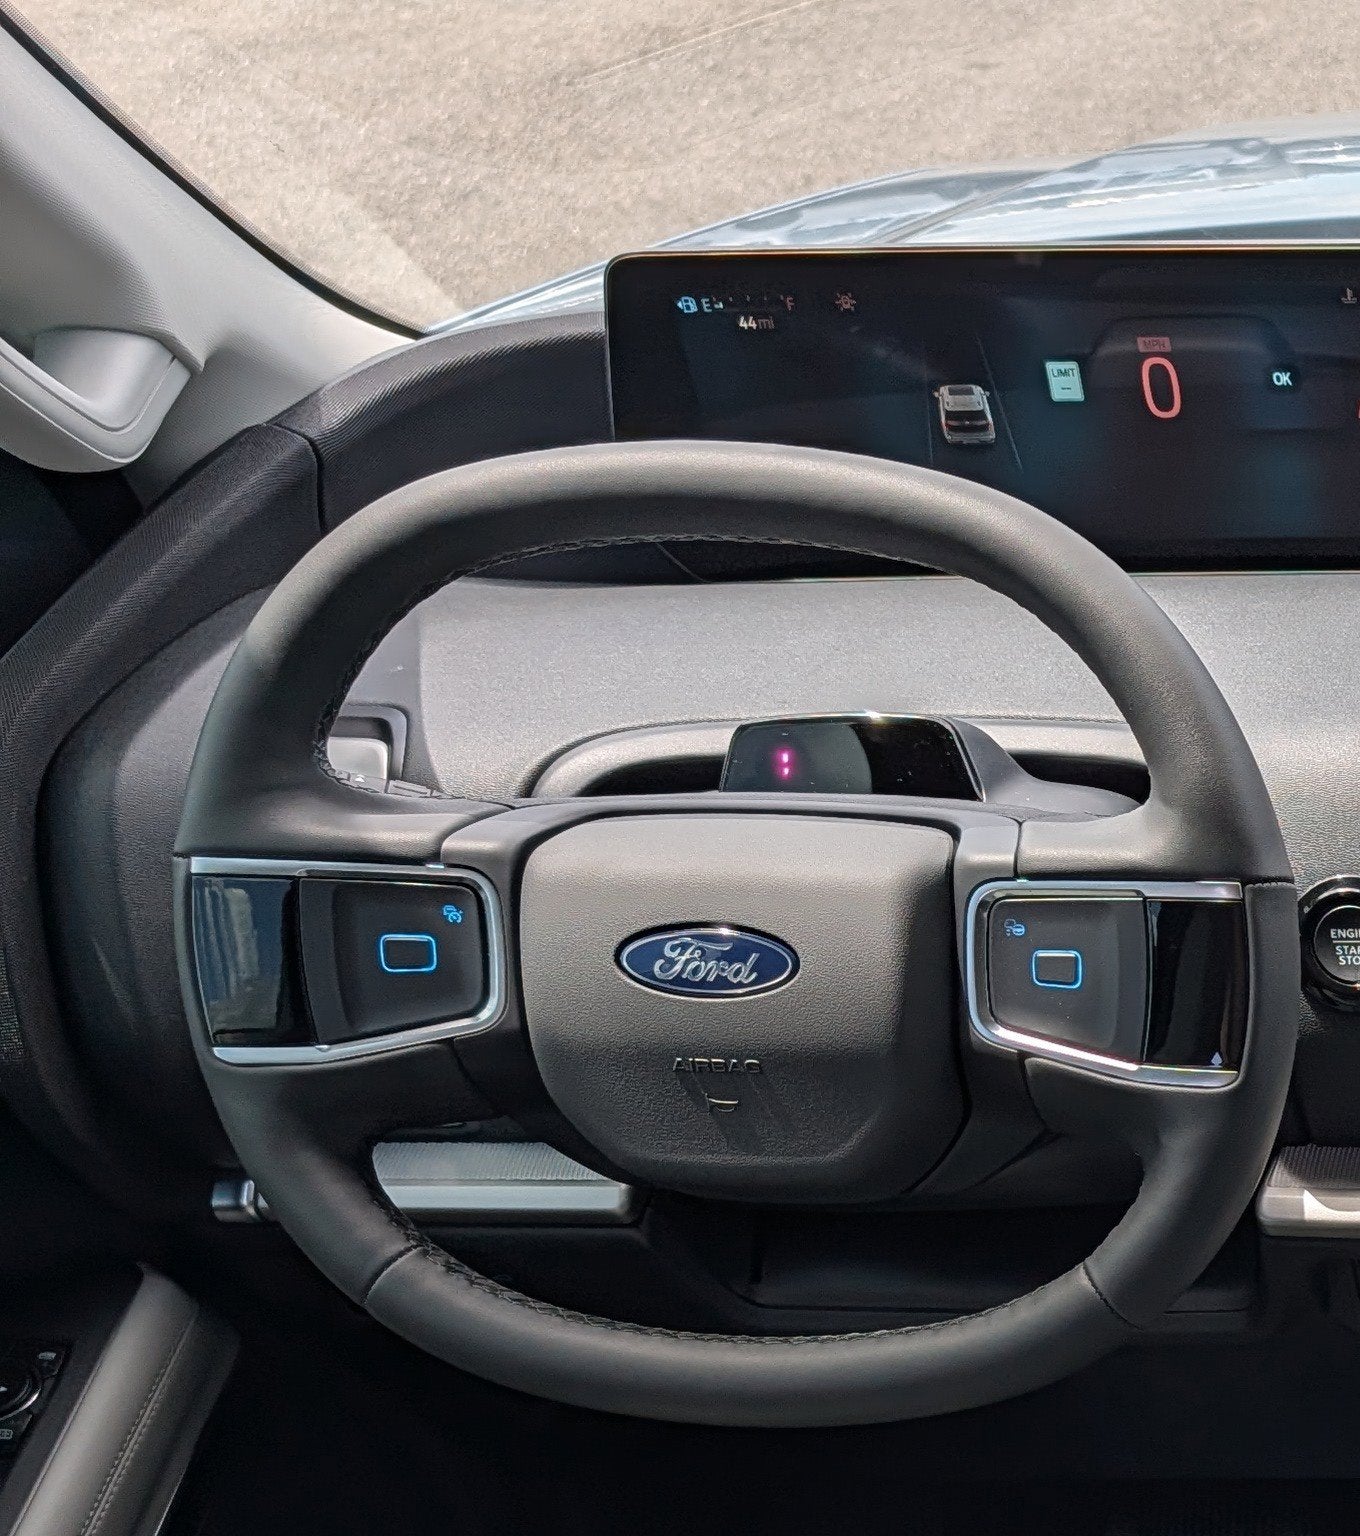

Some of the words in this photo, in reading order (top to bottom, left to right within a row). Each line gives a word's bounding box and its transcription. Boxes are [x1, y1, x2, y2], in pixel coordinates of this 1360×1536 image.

[1051, 367, 1076, 378] LIMIT
[1272, 371, 1292, 387] OK
[1141, 356, 1181, 419] 0
[653, 937, 761, 984] Ford
[672, 1057, 762, 1074] AIRBAG
